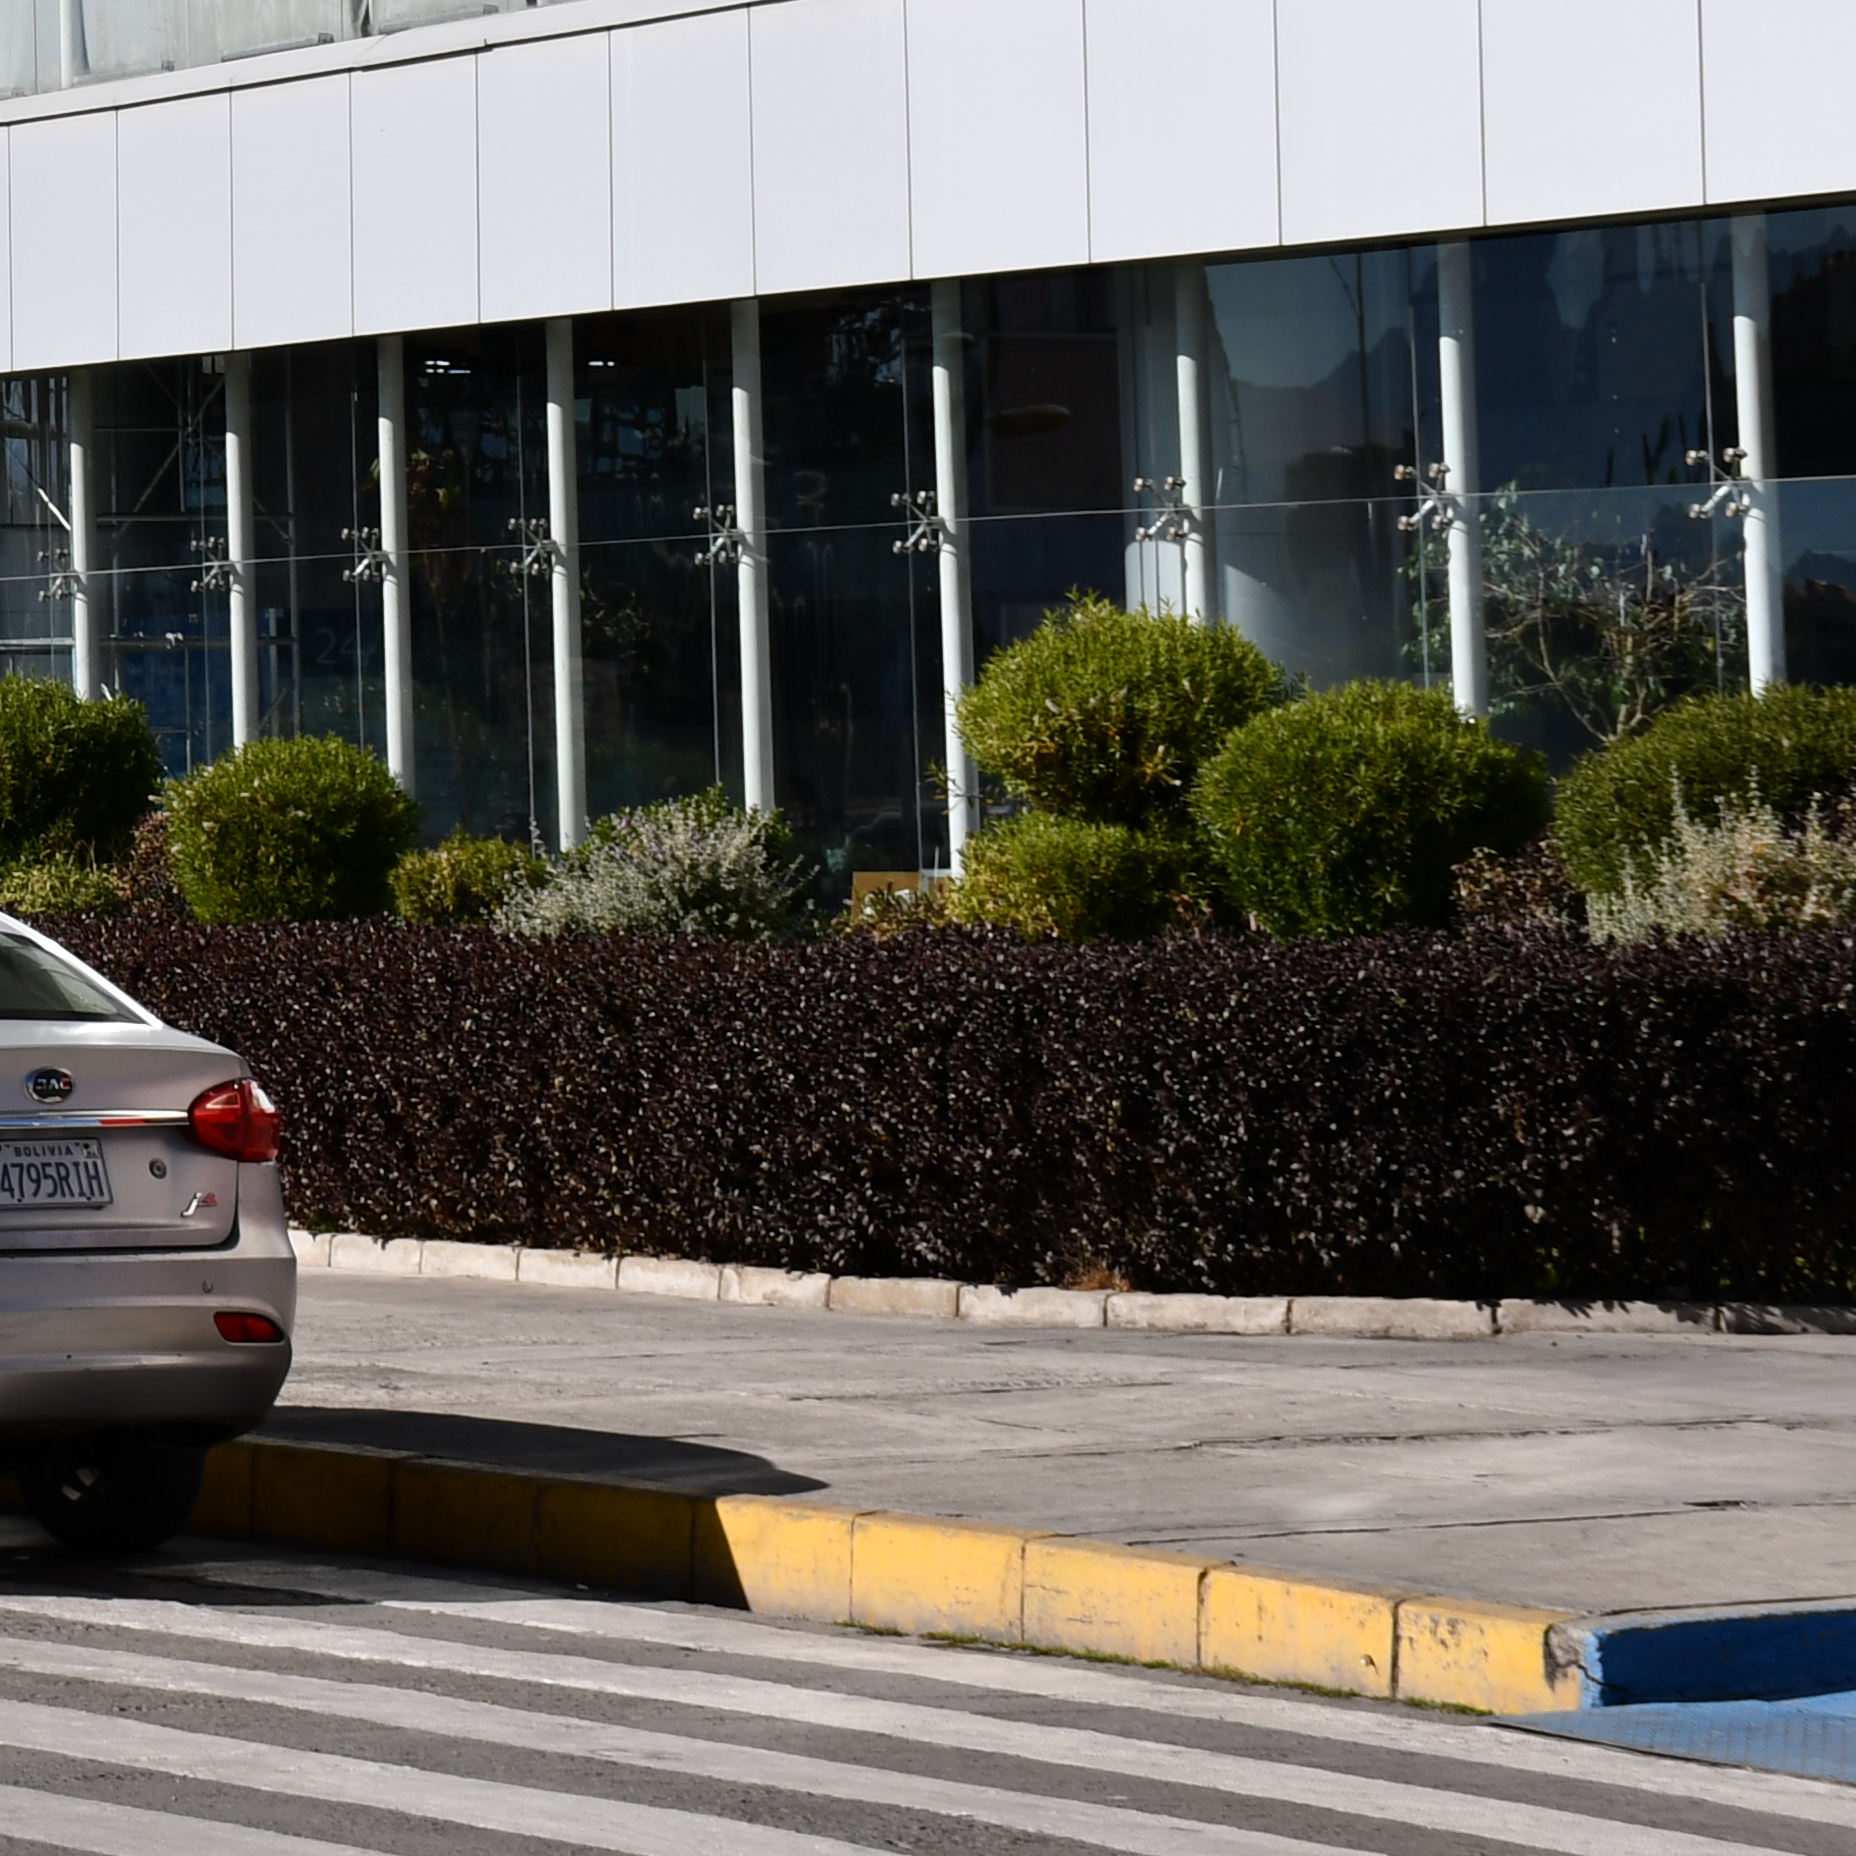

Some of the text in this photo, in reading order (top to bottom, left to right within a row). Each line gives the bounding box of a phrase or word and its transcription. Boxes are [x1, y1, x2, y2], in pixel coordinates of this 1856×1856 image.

[35, 1077, 71, 1091] JAC
[14, 1145, 74, 1158] BOLIVIA
[0, 1160, 105, 1200] 4795RIH
